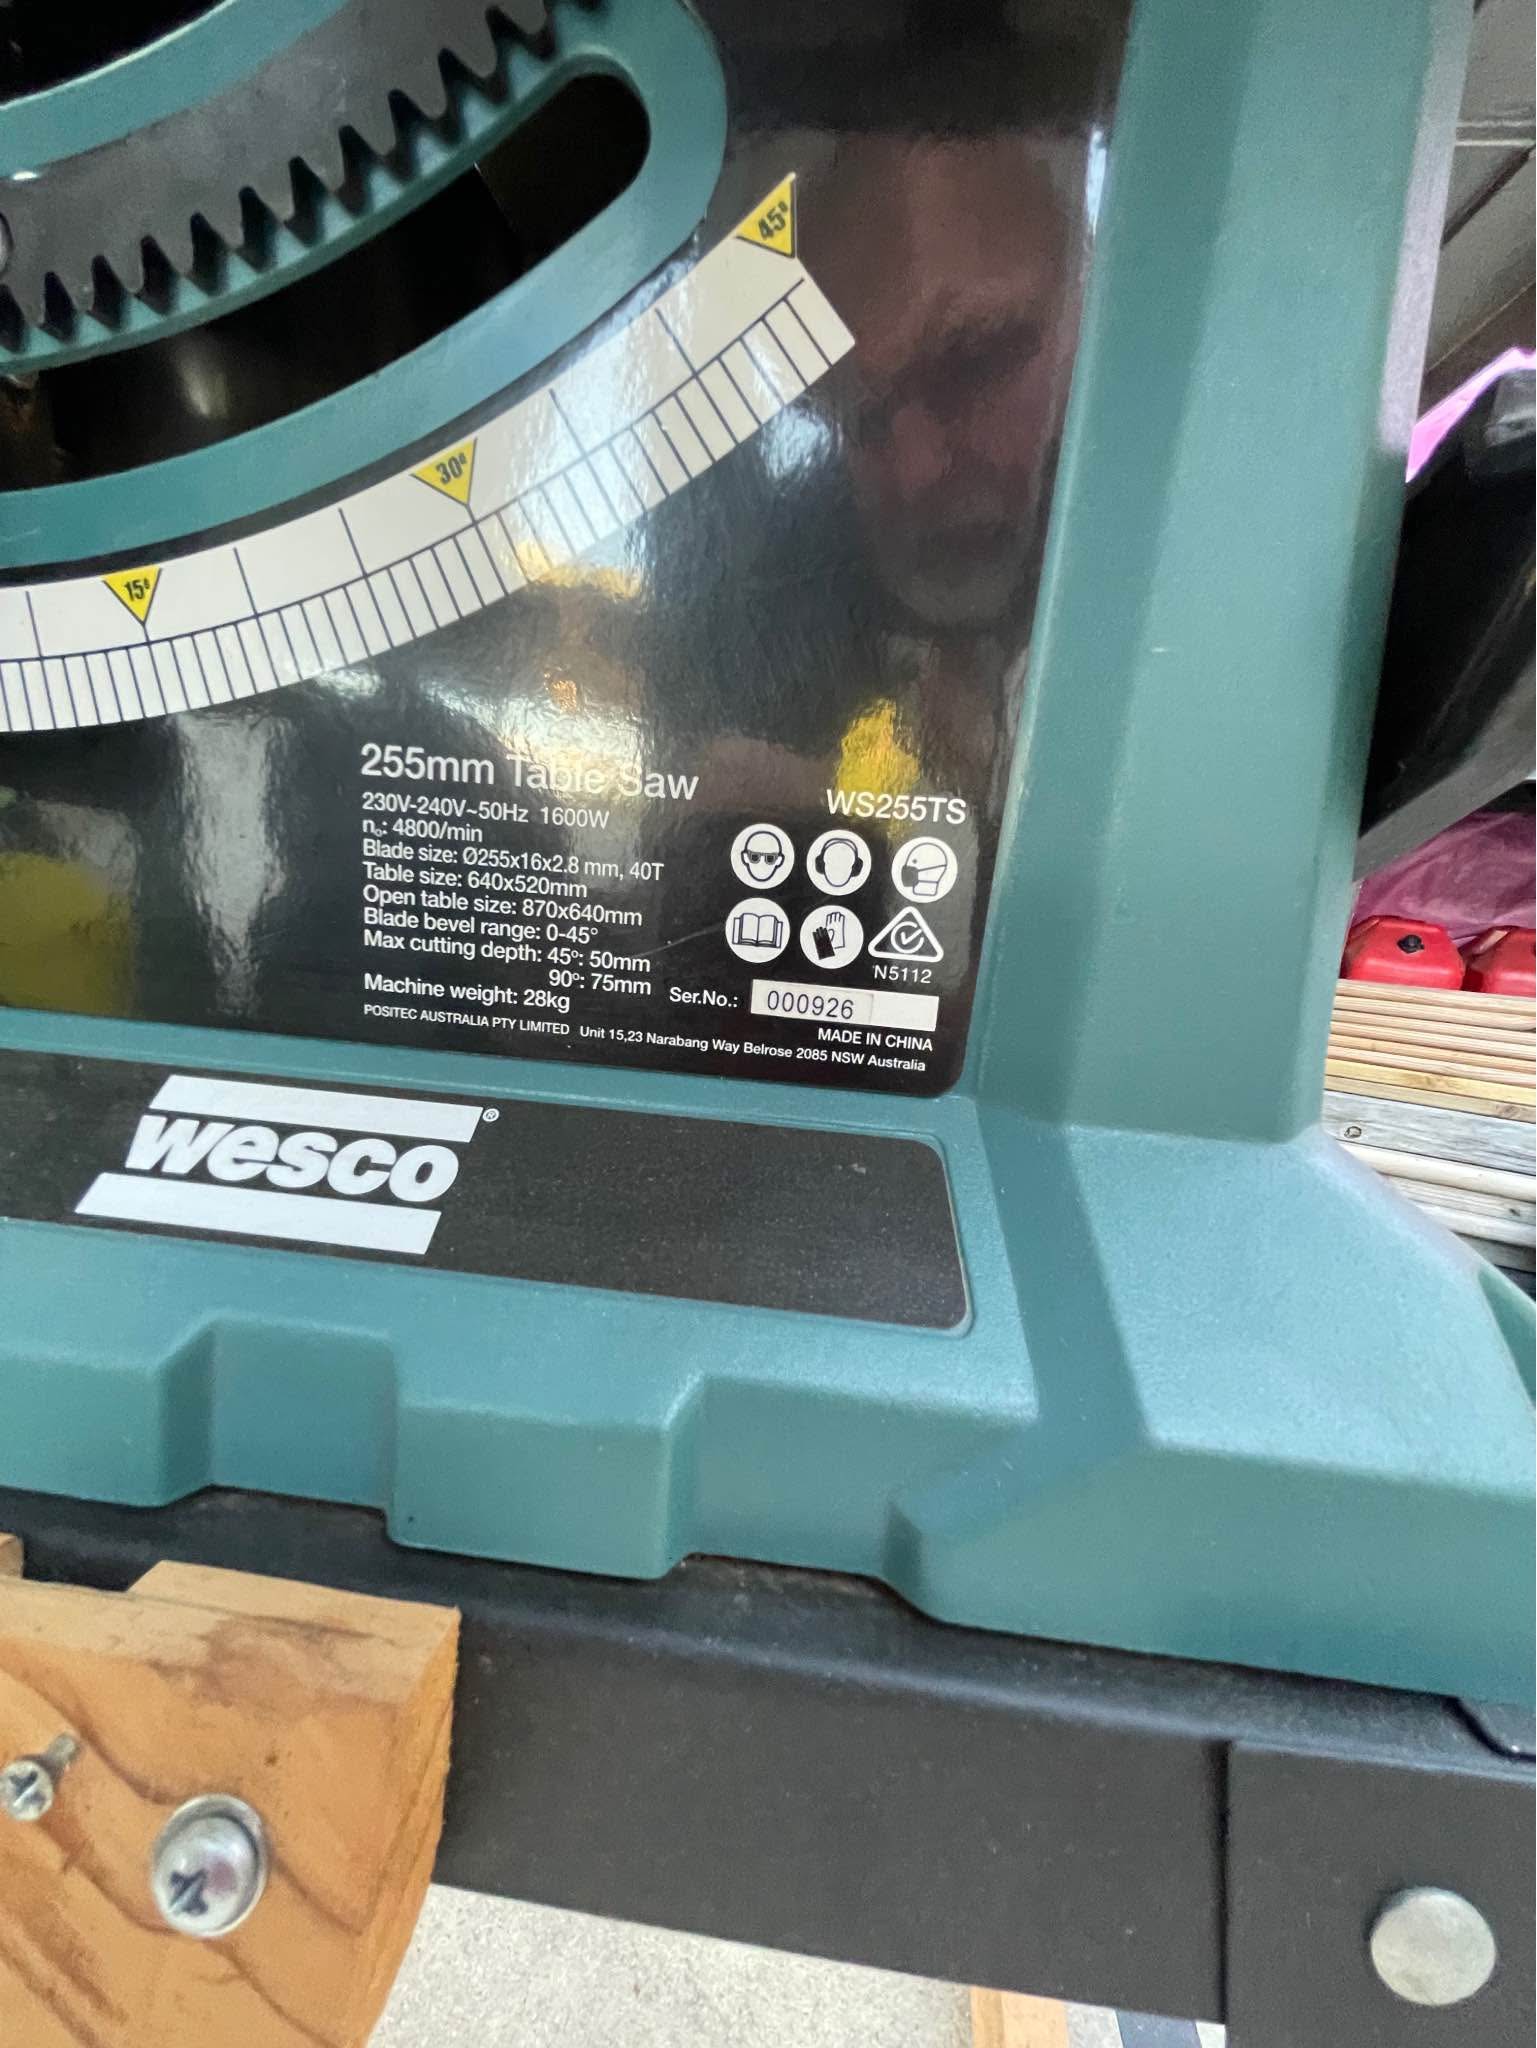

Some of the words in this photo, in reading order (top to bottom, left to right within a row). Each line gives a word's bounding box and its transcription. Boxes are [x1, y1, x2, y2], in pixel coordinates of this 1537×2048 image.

[361, 742, 494, 785] 255mm
[506, 754, 608, 794] Table
[618, 762, 699, 800] Saw
[540, 806, 610, 829] 1600W
[826, 789, 967, 825] WS255TS
[392, 818, 482, 842] 4800/min
[363, 838, 414, 860] Blade
[418, 843, 458, 864] size:
[584, 861, 624, 881] mm,
[630, 862, 664, 881] 40T
[362, 861, 414, 883] Table
[419, 867, 462, 887] size:
[468, 871, 588, 898] 640x520mm
[363, 884, 416, 907] Open
[420, 889, 469, 910] table
[473, 895, 517, 915] size:
[522, 900, 642, 926] 870x640mm
[364, 907, 419, 928] Blade
[424, 912, 475, 933] bevel
[480, 920, 541, 942] range:
[364, 929, 405, 949] Max
[410, 937, 476, 961] cutting
[481, 940, 542, 963] depth:
[589, 951, 651, 972] 50mm
[591, 973, 651, 995] 75mm
[873, 964, 932, 984] N5112
[364, 973, 445, 997] Machine
[450, 984, 518, 1008] weight:
[523, 989, 570, 1013] 28kg
[669, 987, 738, 1008] Ser.No.:
[767, 990, 855, 1020] 000926
[364, 1004, 417, 1020] POSITEC
[420, 1010, 489, 1027] AUSTRALIA
[492, 1017, 516, 1030] PTY
[519, 1020, 570, 1035] LIMITED
[580, 1025, 605, 1039] Unit
[609, 1029, 643, 1043] 15,23
[646, 1032, 709, 1051] Narabang
[712, 1038, 740, 1055] Way
[743, 1041, 792, 1058] Belrose
[796, 1048, 828, 1061] 2085
[831, 1051, 865, 1065] NSW
[868, 1054, 926, 1072] Australia
[818, 1027, 862, 1045] MADE
[866, 1032, 882, 1047] IN
[885, 1035, 933, 1051] CHINA
